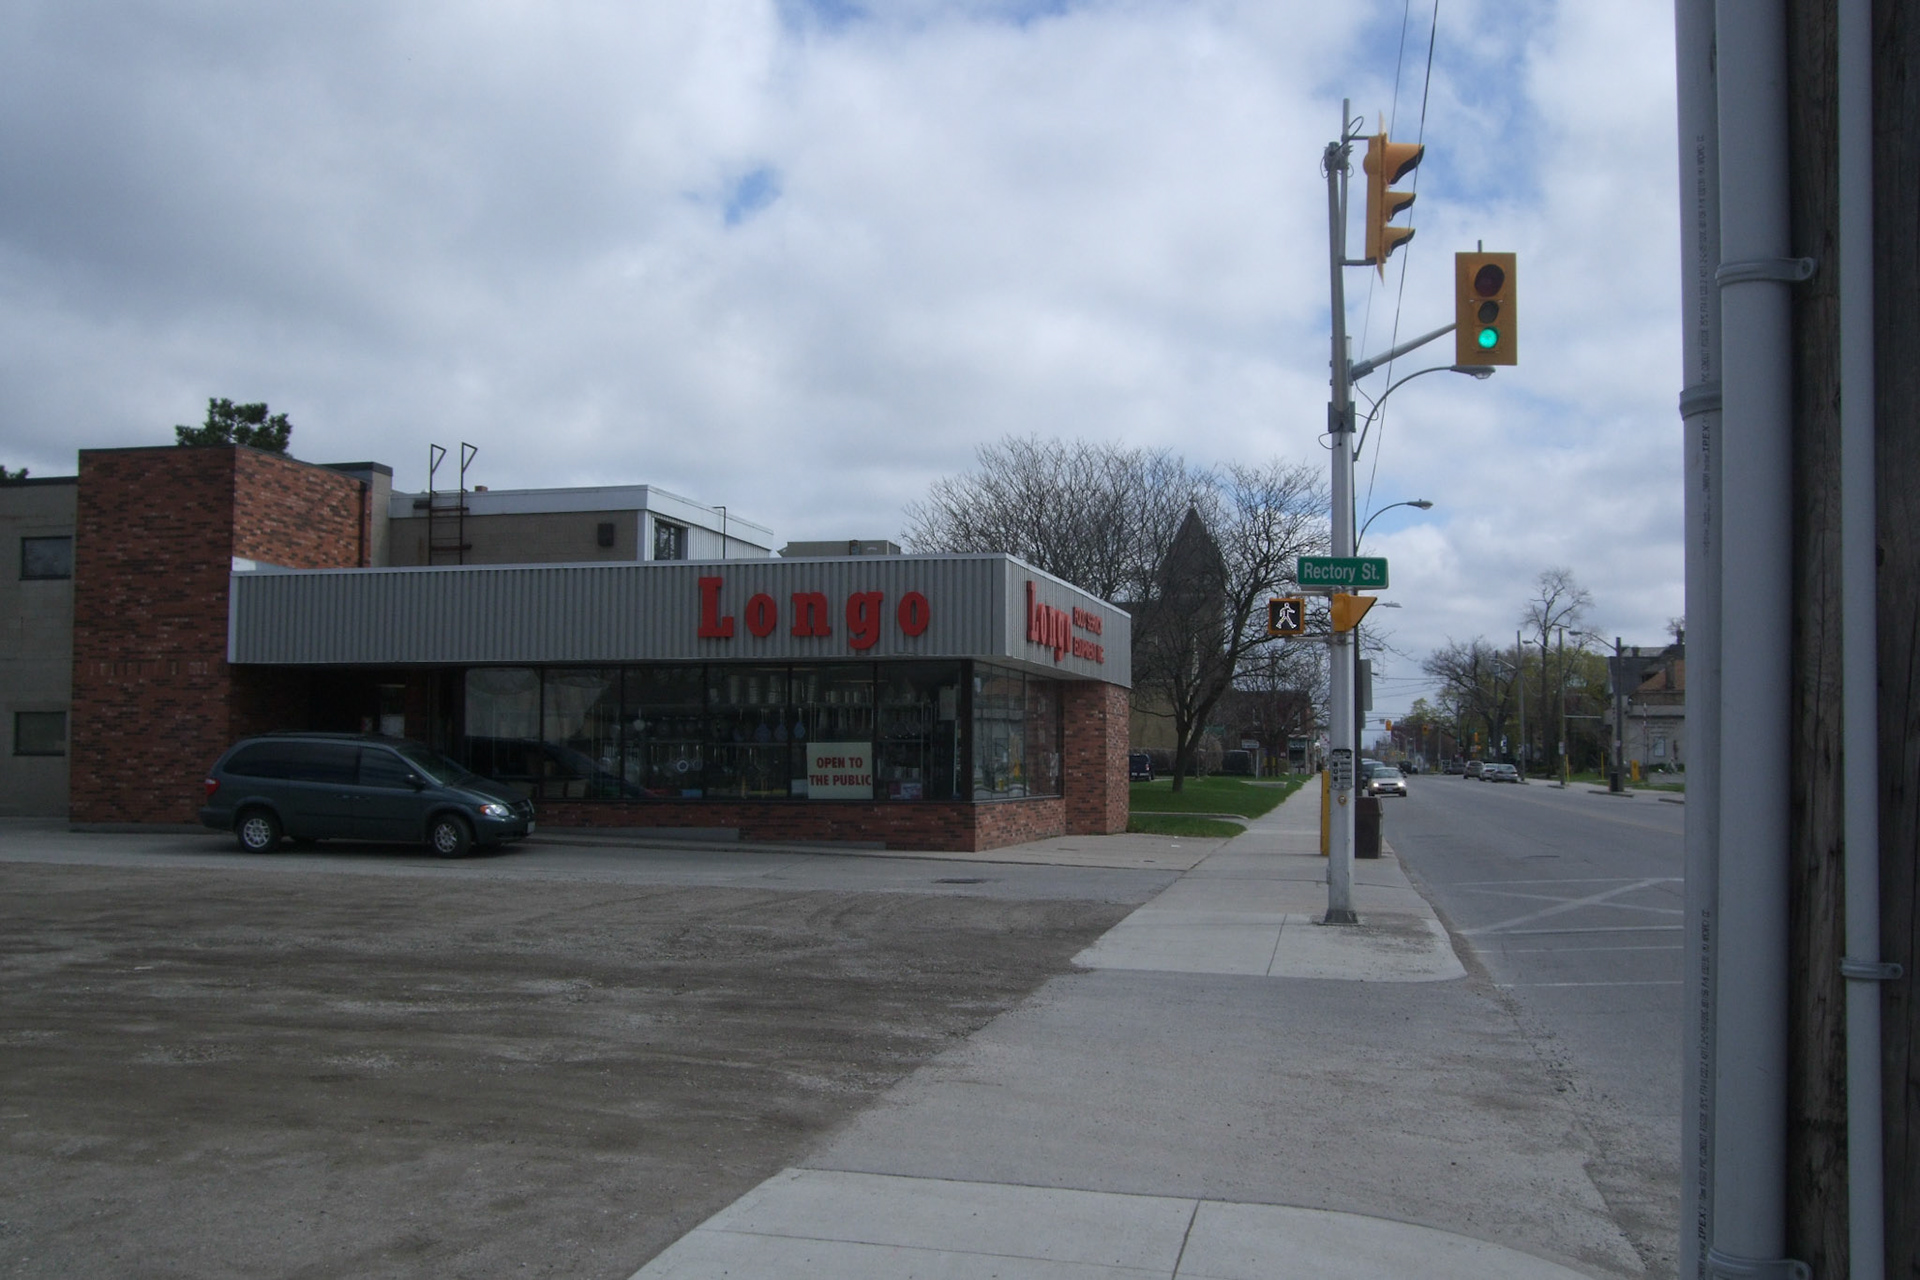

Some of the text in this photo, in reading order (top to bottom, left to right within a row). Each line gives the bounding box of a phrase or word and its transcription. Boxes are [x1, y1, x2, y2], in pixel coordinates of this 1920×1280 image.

[1304, 563, 1380, 582] Rectory St.
[698, 576, 931, 650] Longo
[1026, 581, 1072, 662] Longo
[816, 757, 863, 769] OPEN TO
[809, 774, 872, 786] THE PUBLIC
